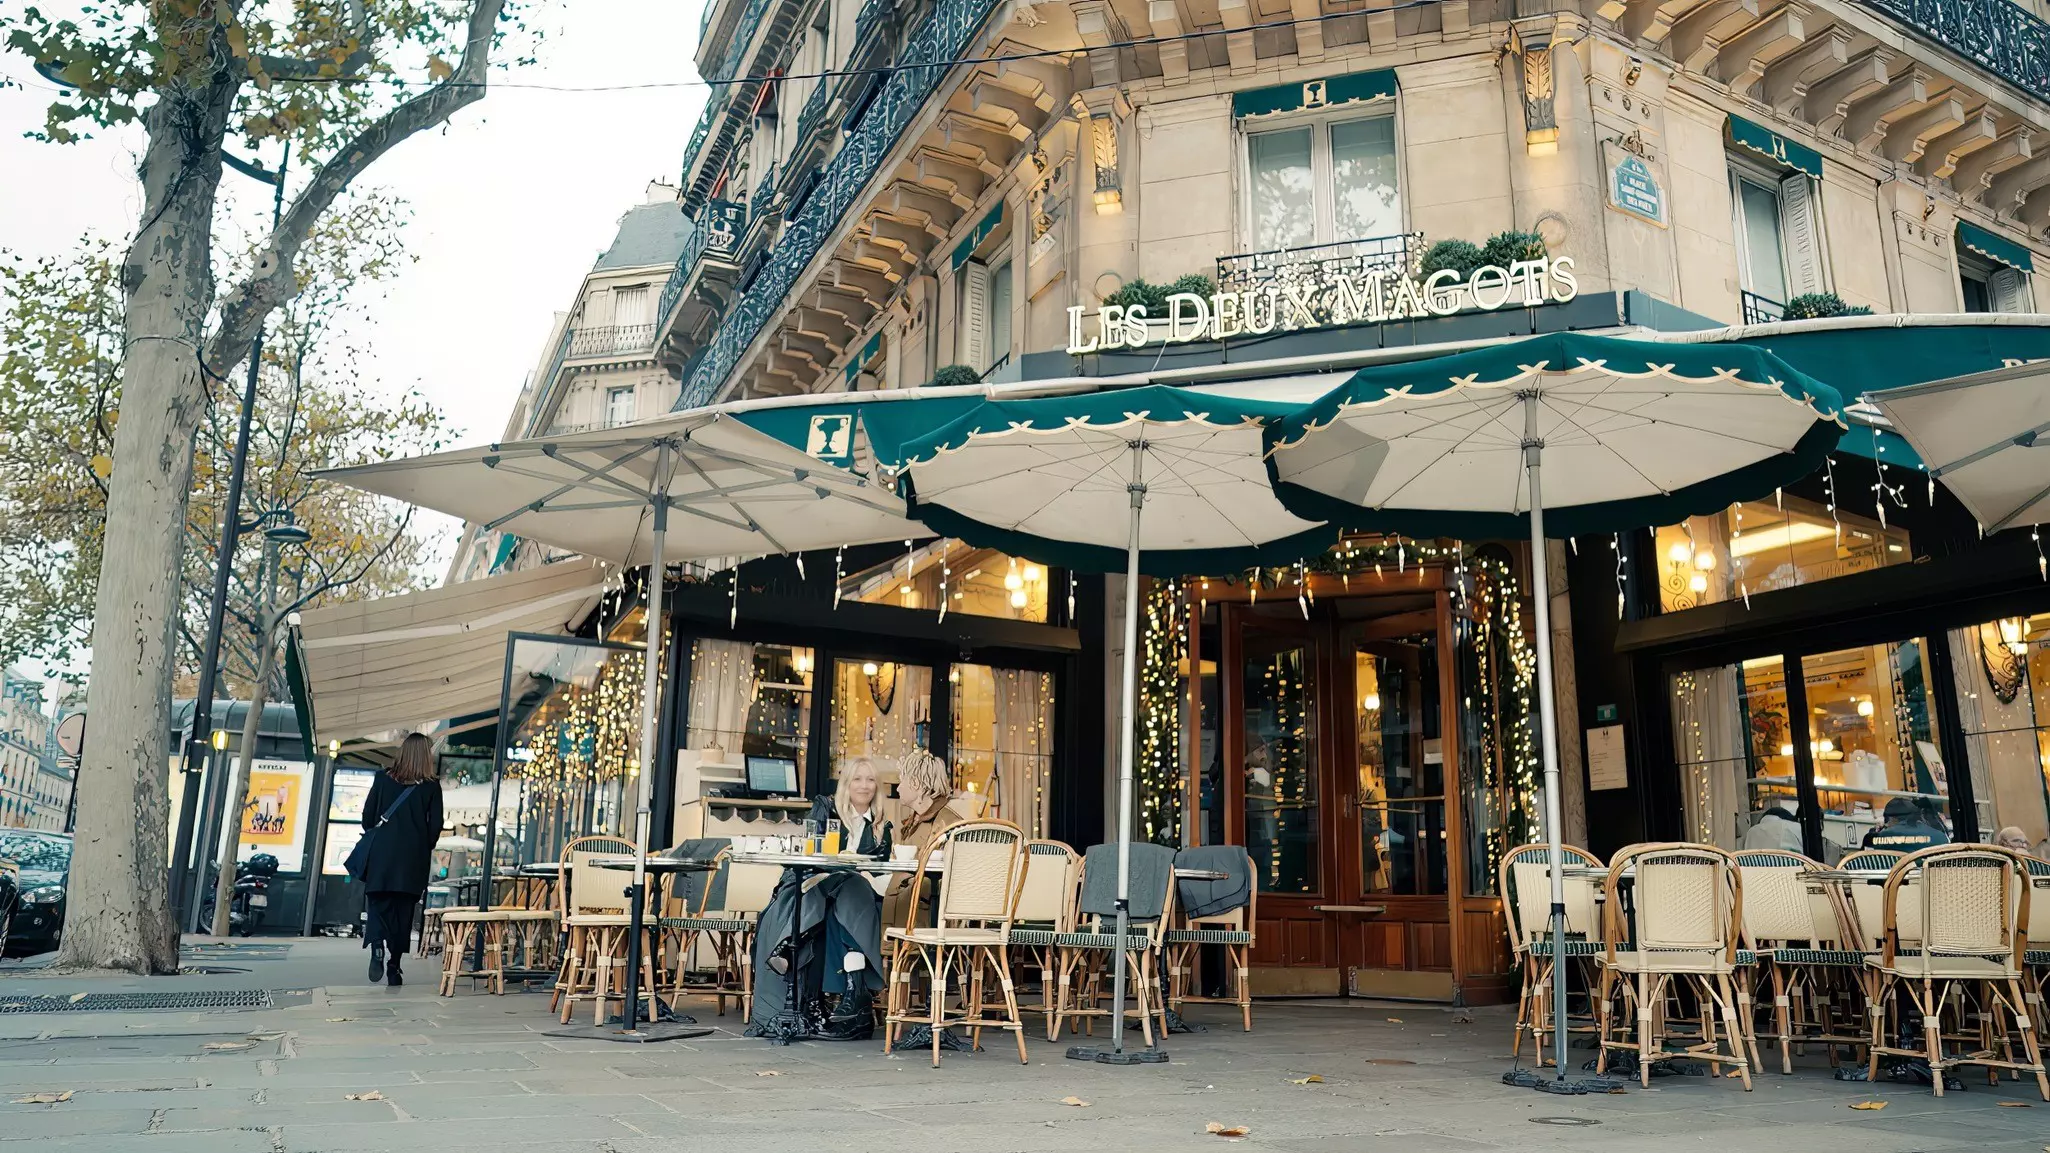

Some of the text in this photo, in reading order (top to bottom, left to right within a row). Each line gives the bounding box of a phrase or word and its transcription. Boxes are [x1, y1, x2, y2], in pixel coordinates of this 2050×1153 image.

[1066, 256, 1578, 354] LES DEUX MAGOTS
